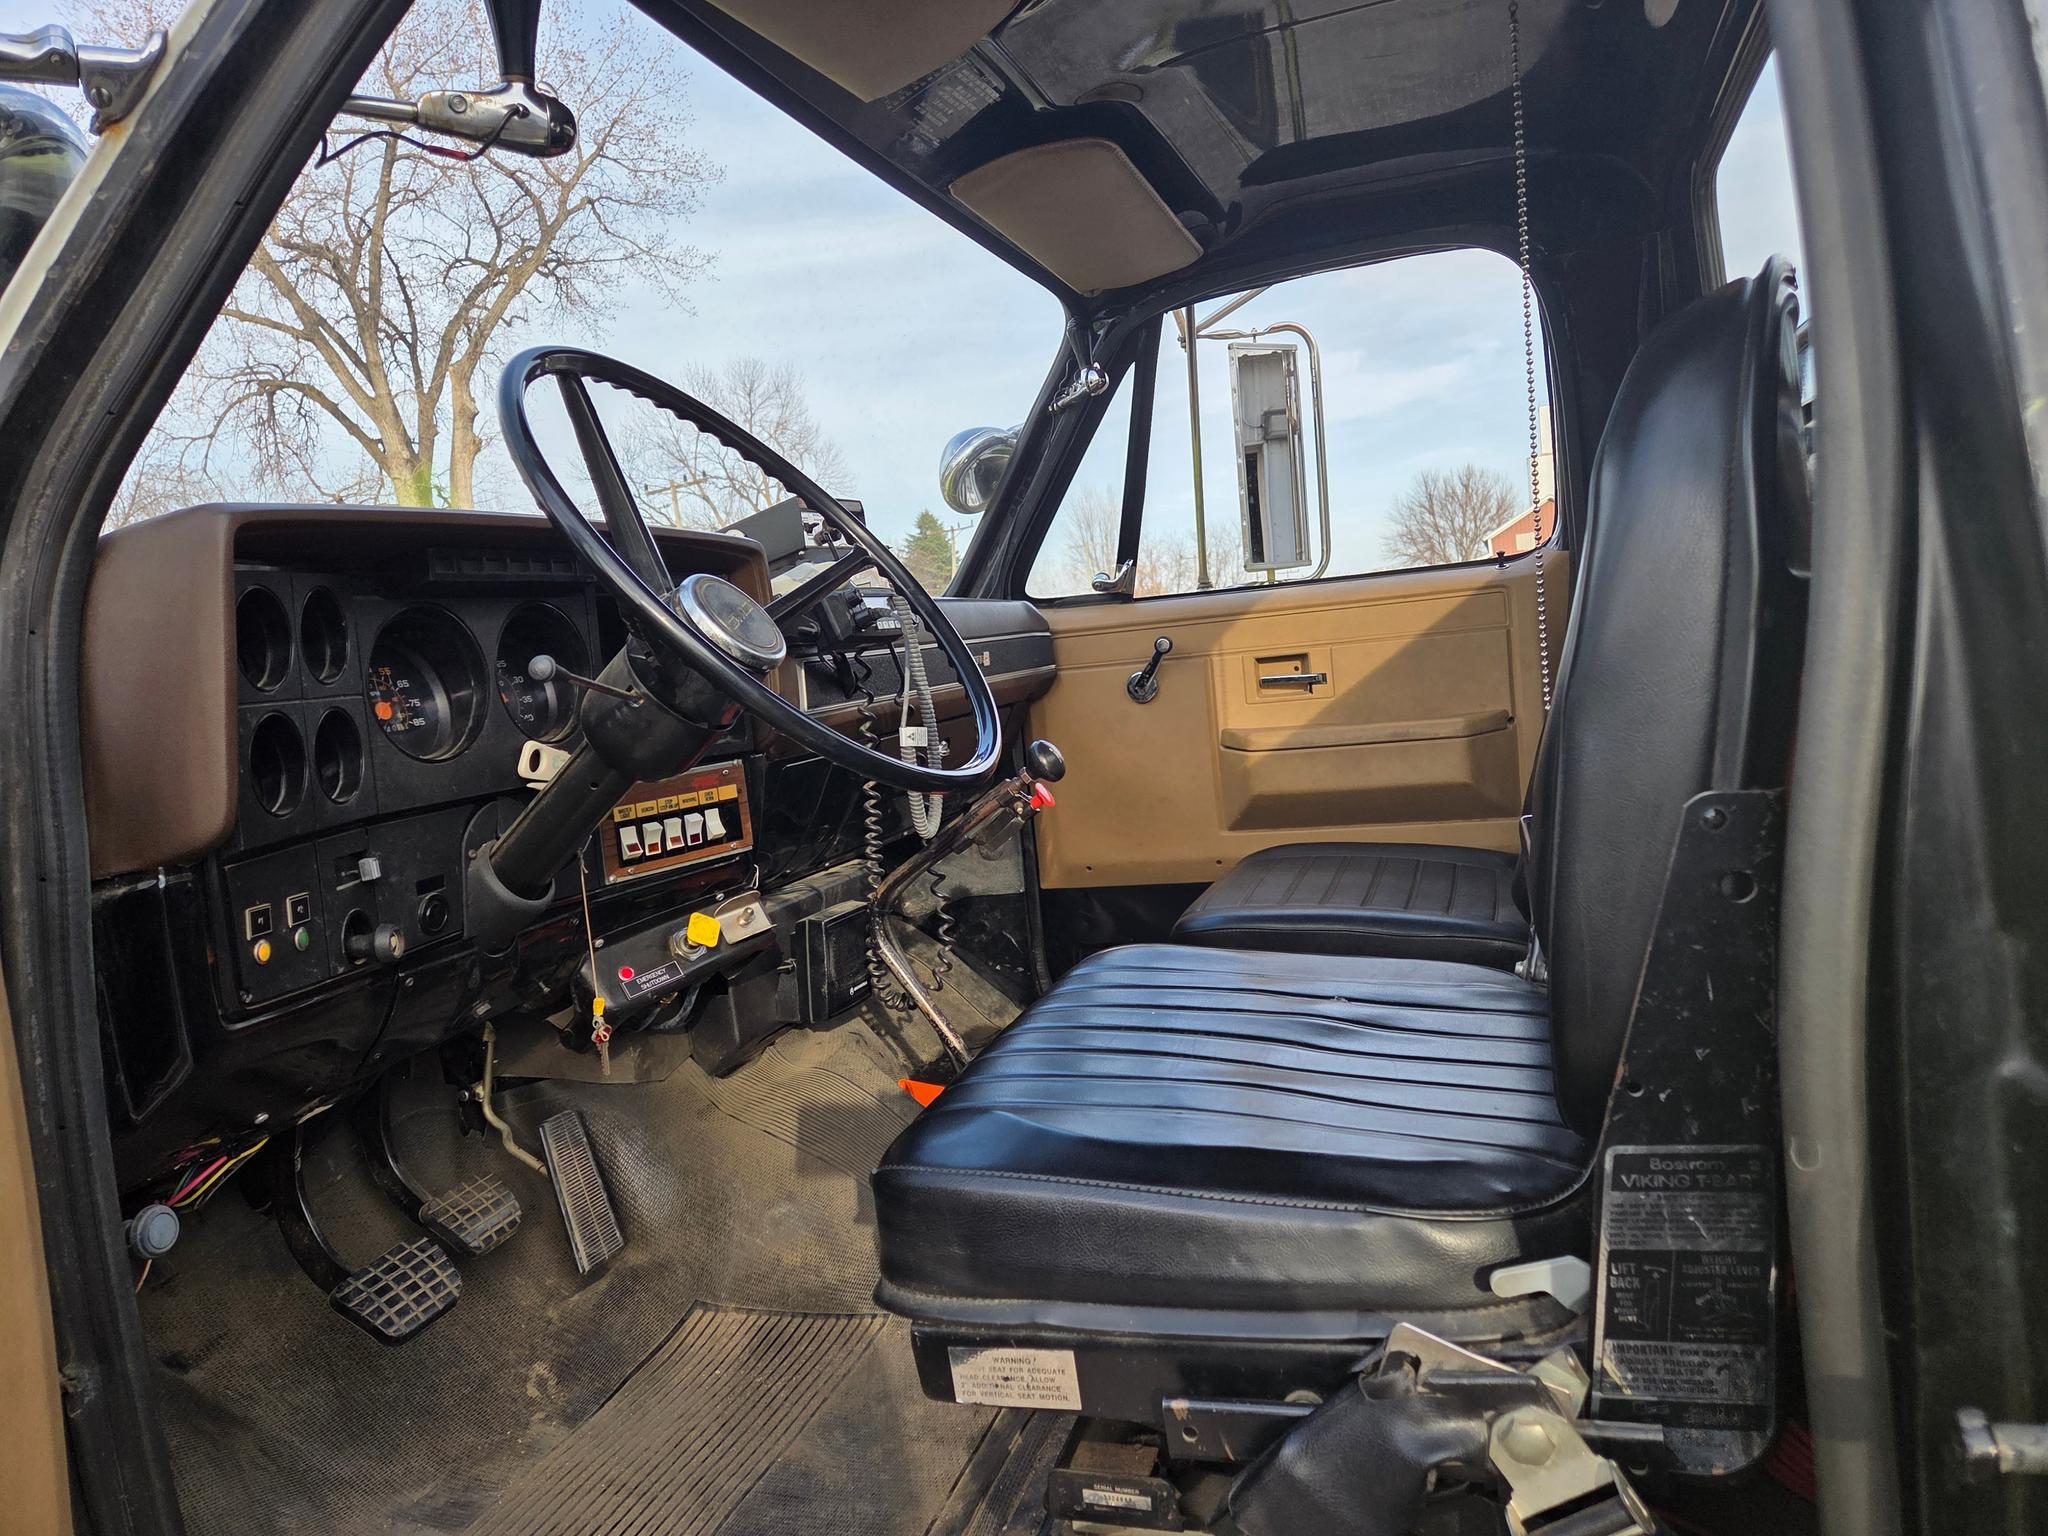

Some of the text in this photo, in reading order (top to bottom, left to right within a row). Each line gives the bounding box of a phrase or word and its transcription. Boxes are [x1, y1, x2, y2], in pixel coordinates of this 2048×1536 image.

[378, 667, 391, 675] 55
[397, 680, 409, 688] 65
[513, 676, 524, 684] 30
[408, 699, 421, 707] 75
[522, 695, 533, 703] 35
[412, 718, 426, 726] 85
[636, 968, 666, 985] EMERGENCY
[640, 974, 670, 990] SHUTDOWN
[1649, 1157, 1727, 1171] Bostrom
[1621, 1174, 1691, 1189] VIKING
[1611, 1262, 1636, 1275] LIFT
[1609, 1276, 1641, 1289] BACK
[1613, 1343, 1673, 1355] IMPORTANT
[1663, 1358, 1711, 1368] PRELOAD
[1027, 1368, 1066, 1376] ADEQUATE
[1030, 1376, 1056, 1384] ALLOW
[1017, 1383, 1061, 1393] CLEARANCE
[980, 1391, 1013, 1399] VERTICAL
[1017, 1392, 1036, 1400] SEAT
[1094, 1483, 1140, 1494] SERIAL NUMBER
